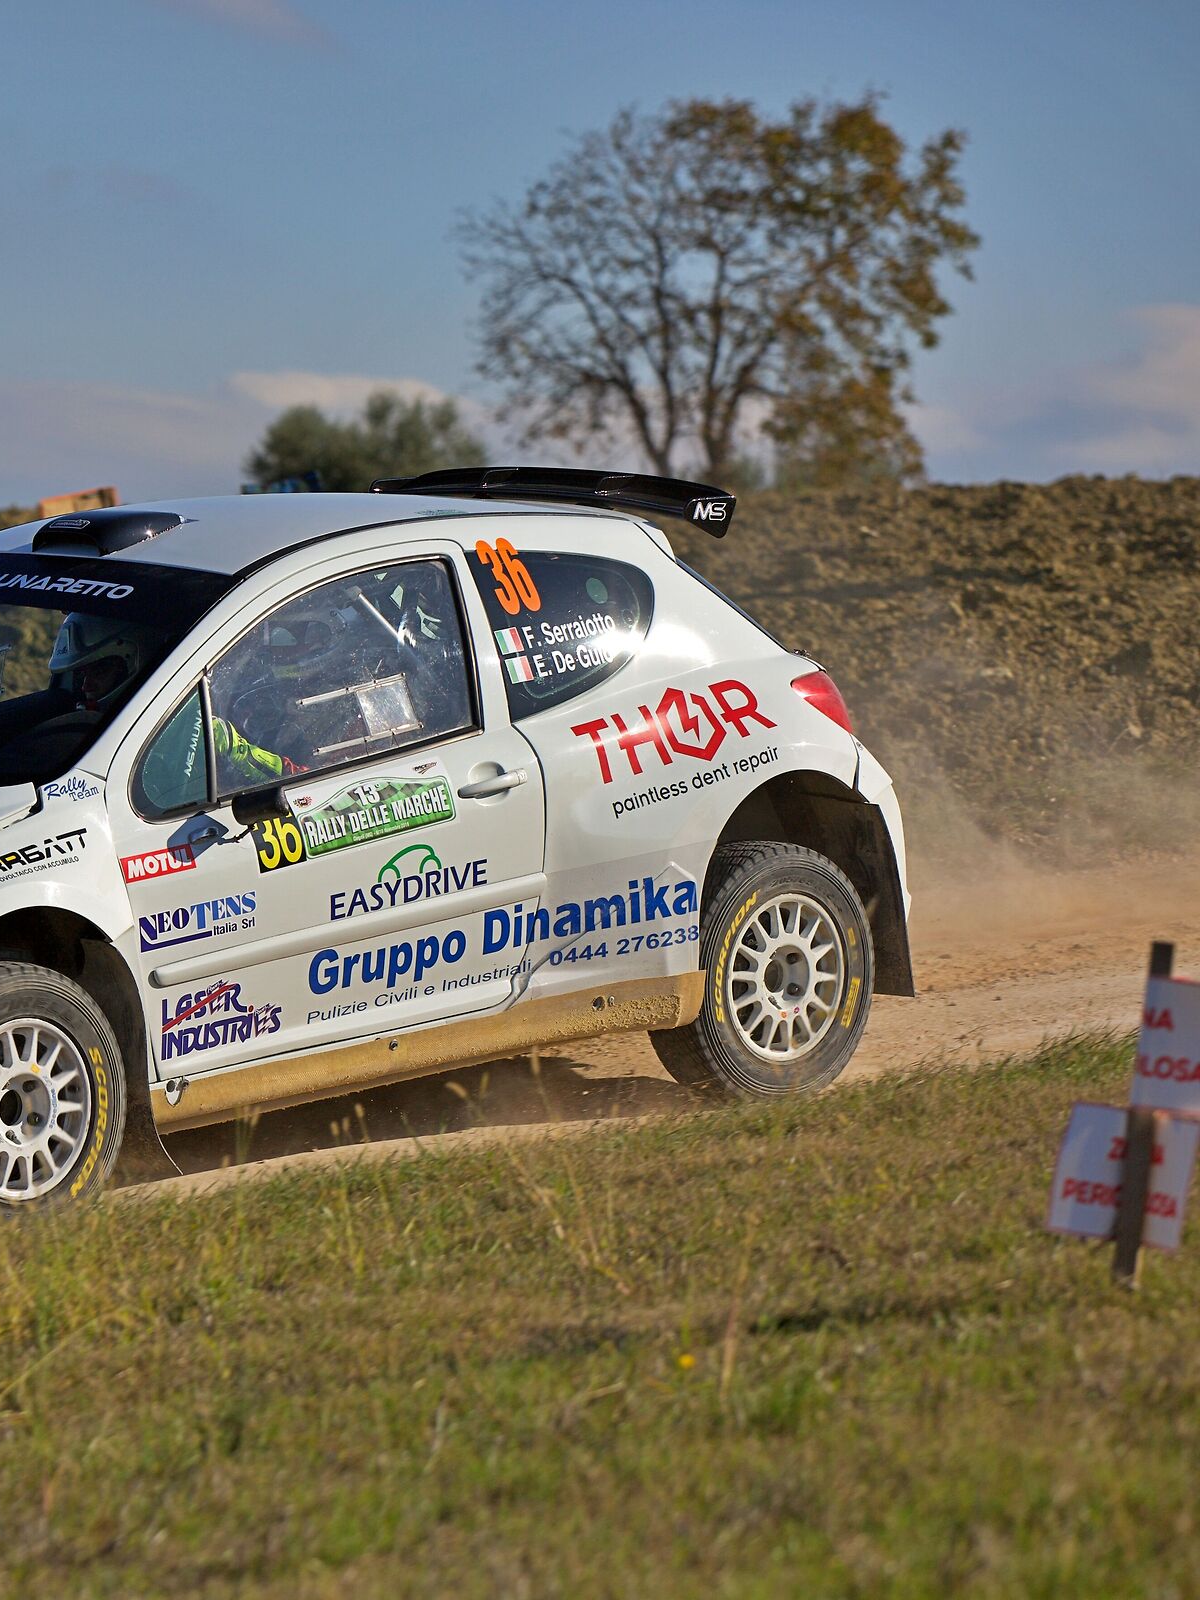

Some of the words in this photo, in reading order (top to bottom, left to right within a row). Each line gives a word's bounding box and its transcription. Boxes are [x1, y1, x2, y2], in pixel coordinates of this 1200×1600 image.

[693, 501, 727, 521] MS
[475, 537, 542, 616] 36
[522, 625, 543, 649] F.
[541, 612, 616, 646] Serraiotto
[533, 654, 553, 678] E.
[552, 650, 577, 675] De
[569, 679, 778, 785] THOR
[43, 776, 88, 801] Rally
[69, 784, 100, 802] Team
[611, 780, 689, 819] paintless
[691, 763, 731, 790] dent
[732, 746, 779, 775] repair
[252, 812, 304, 870] 36
[304, 814, 349, 848] RALLY
[349, 804, 391, 834] DELLE
[391, 784, 450, 822] MARCHE
[33, 864, 48, 873] CON
[48, 855, 80, 869] ACCUMULO
[127, 848, 192, 879] MOTUL
[330, 858, 488, 921] EASYDRIVE
[138, 891, 258, 942] NEOTENS
[213, 922, 238, 937] Italia
[241, 917, 256, 929] Srl
[308, 930, 467, 995] Gruppo
[482, 876, 699, 956] Dinamika
[550, 942, 609, 966] 0444
[616, 925, 699, 956] 276238
[161, 980, 248, 1031] LASER
[306, 1001, 368, 1025] Pulizie
[374, 986, 418, 1008] Civili
[424, 985, 435, 996] e
[442, 959, 532, 992] Industriali
[161, 1003, 282, 1061] INDUSTRIES
